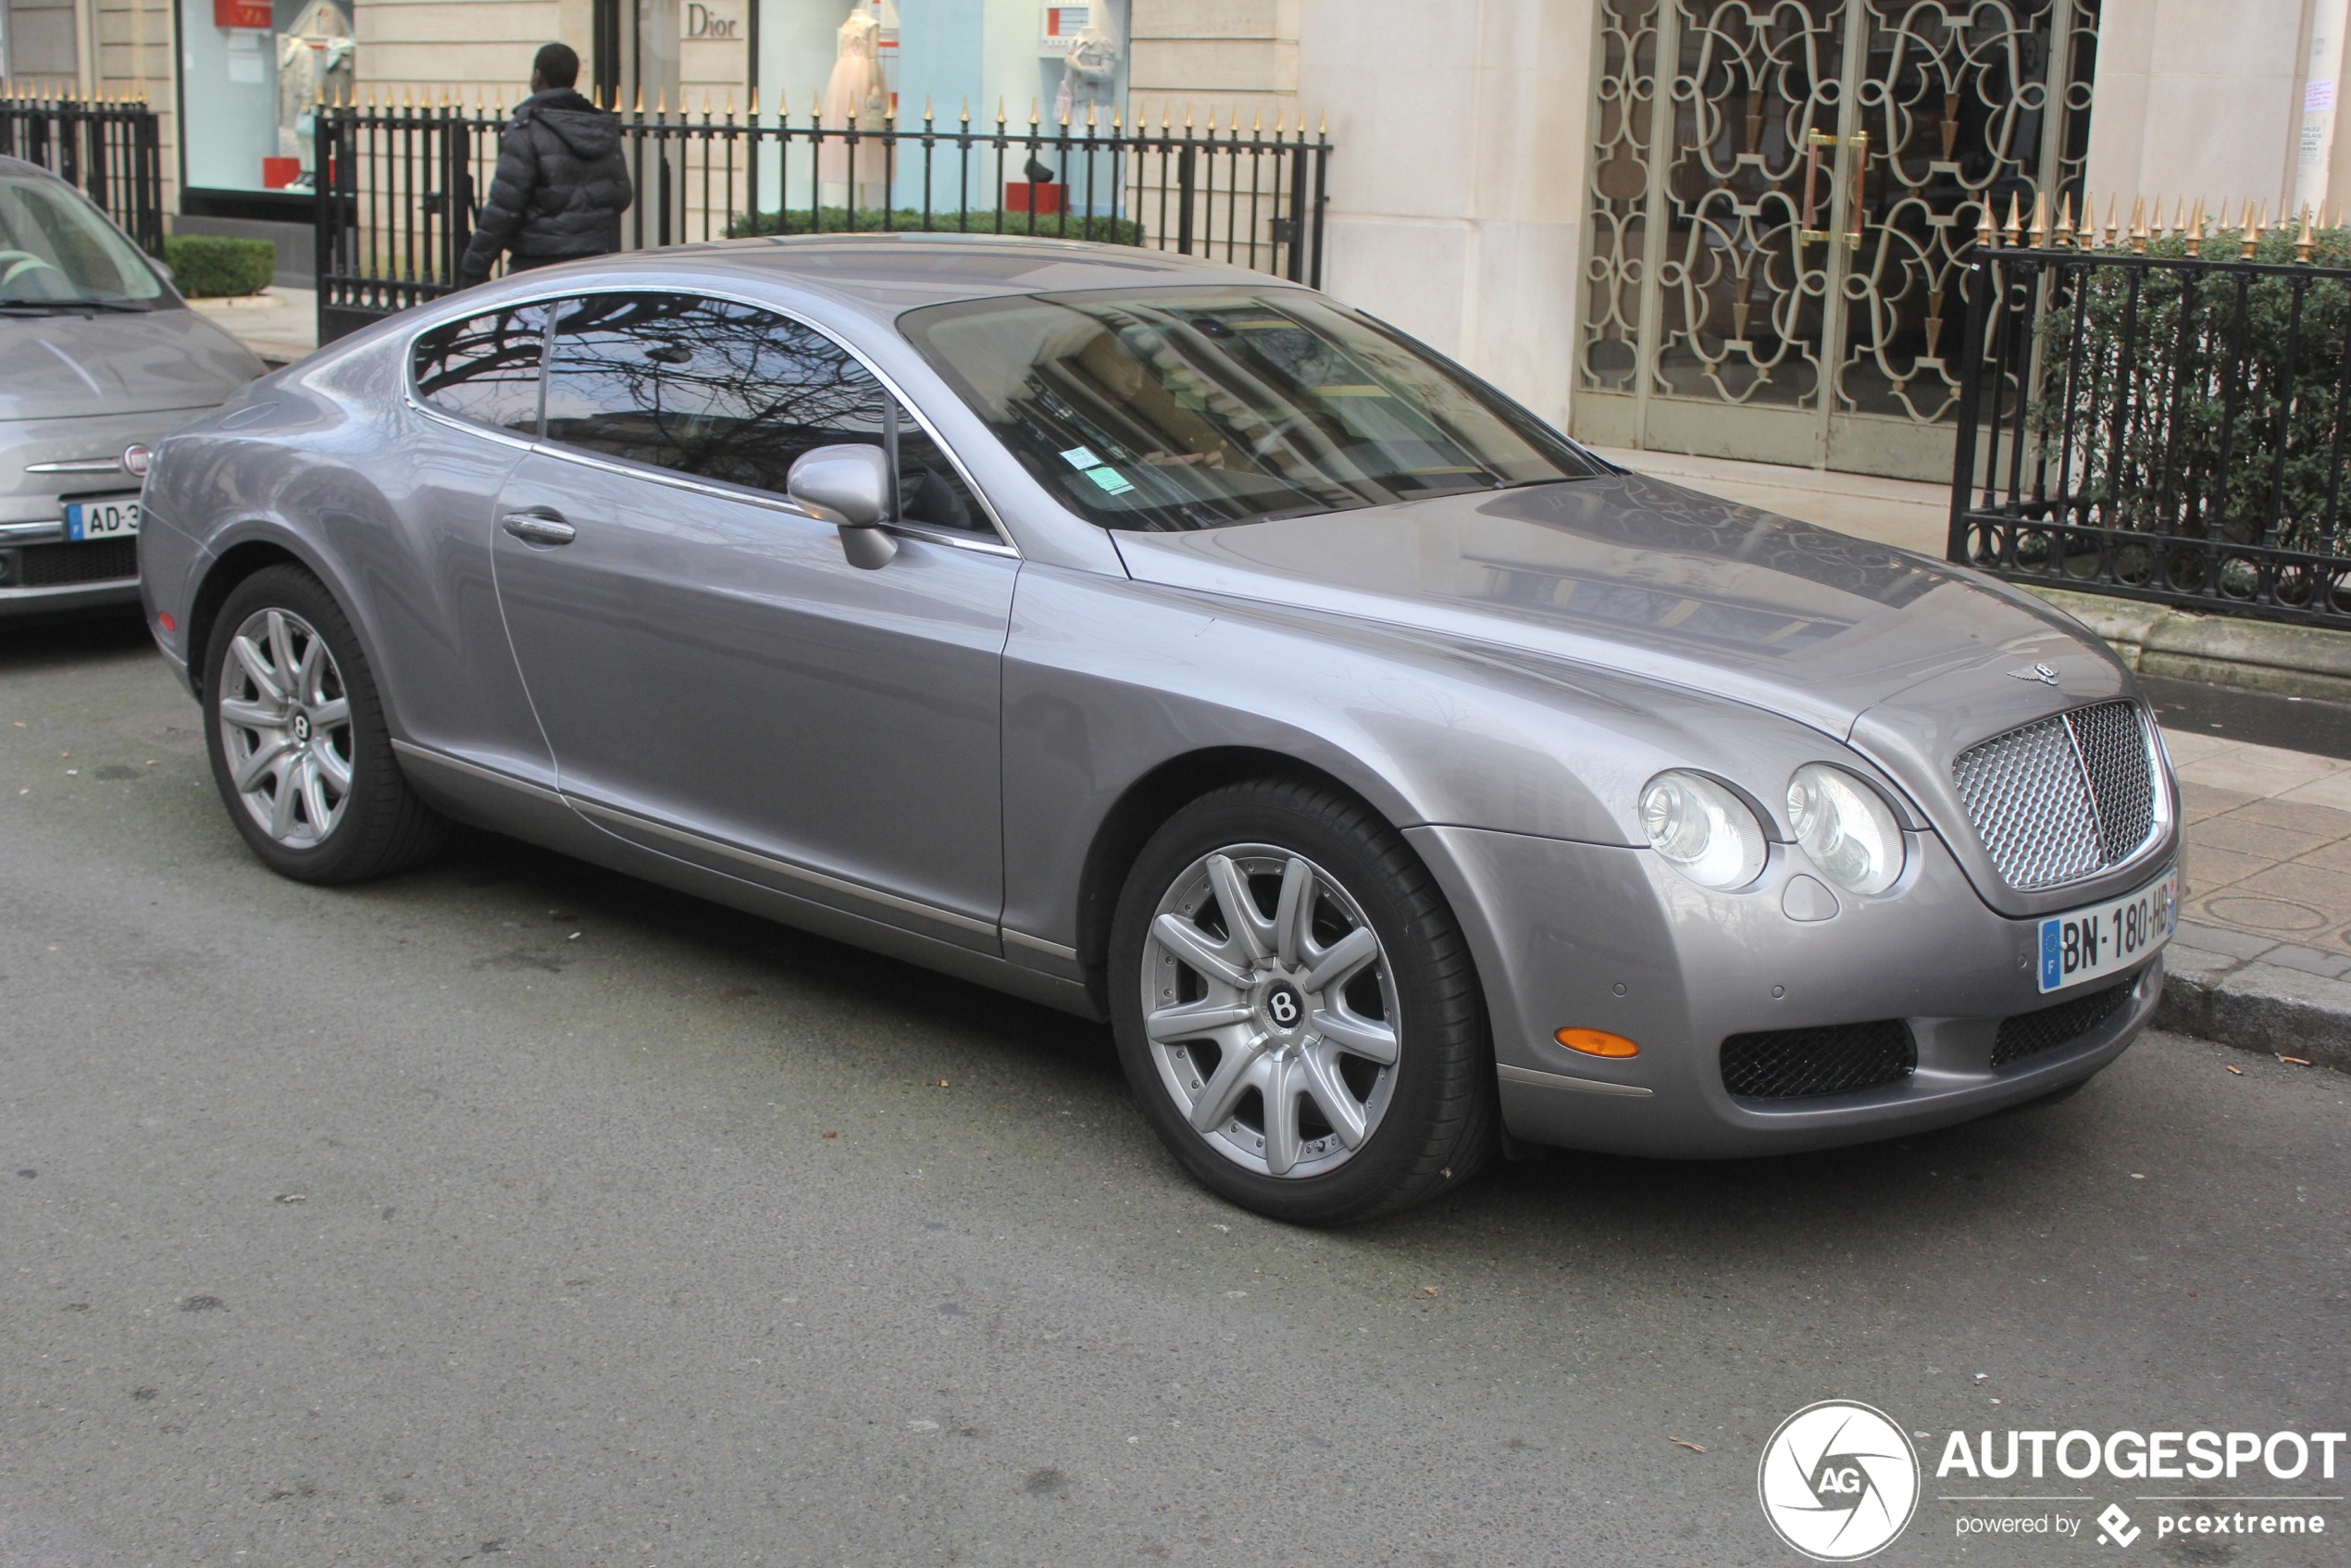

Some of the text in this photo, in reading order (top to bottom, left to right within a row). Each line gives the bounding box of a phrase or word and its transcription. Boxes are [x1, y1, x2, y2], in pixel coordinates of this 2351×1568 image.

[688, 3, 737, 36] Dior
[2063, 883, 2168, 975] BN-180-HB
[2047, 960, 2054, 975] F
[1271, 991, 1297, 1021] B
